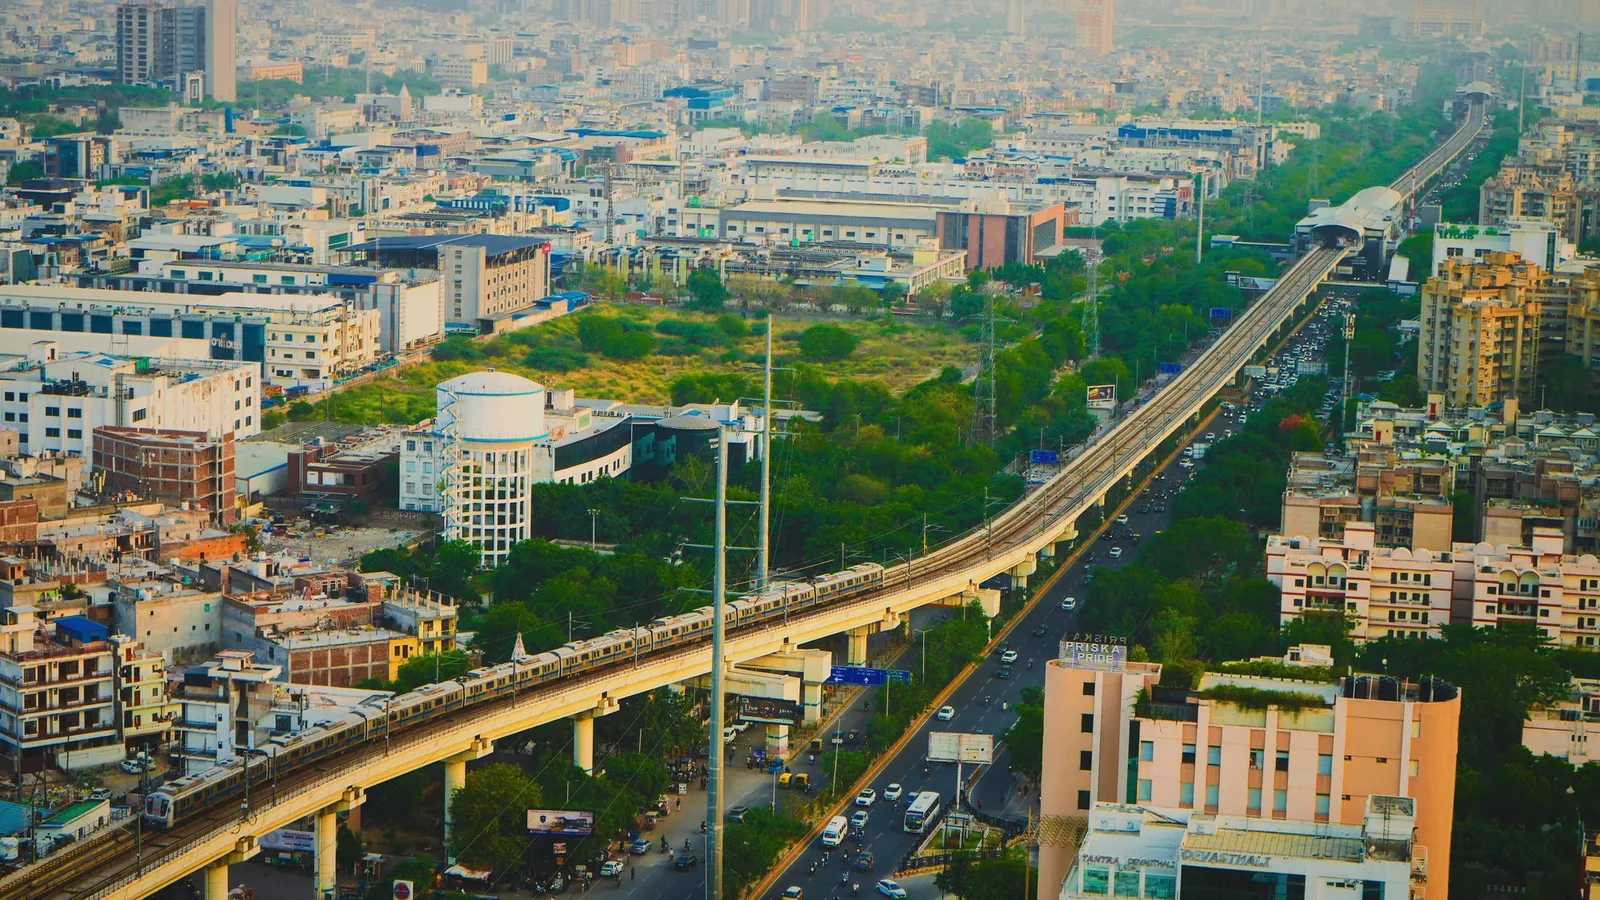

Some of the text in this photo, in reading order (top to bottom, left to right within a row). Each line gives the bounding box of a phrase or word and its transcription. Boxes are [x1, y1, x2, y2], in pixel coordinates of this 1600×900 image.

[1065, 641, 1120, 654] PRISKA
[1077, 652, 1114, 664] PRIDE
[1082, 854, 1120, 864] TANTRA
[1181, 848, 1272, 868] DEVASTHALI
